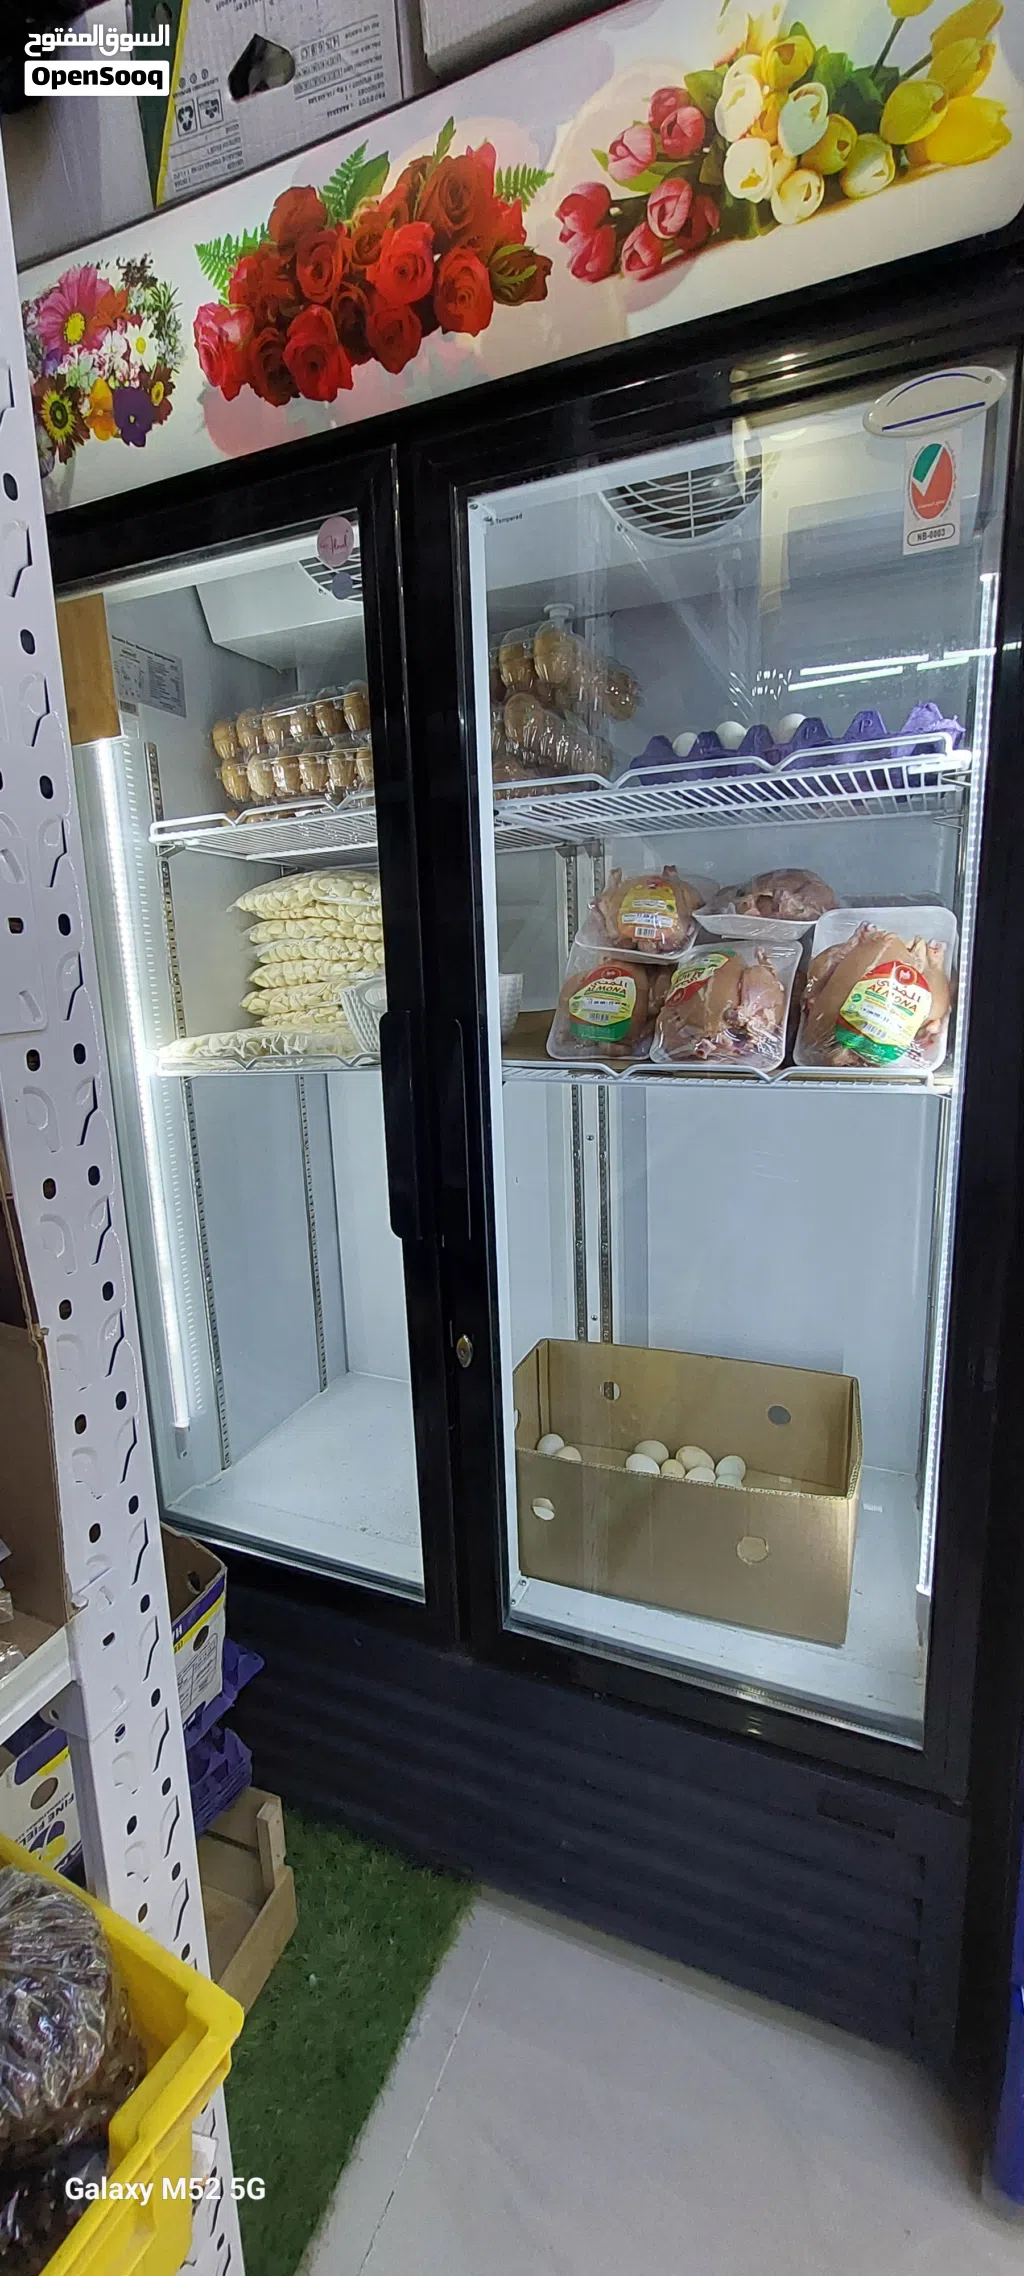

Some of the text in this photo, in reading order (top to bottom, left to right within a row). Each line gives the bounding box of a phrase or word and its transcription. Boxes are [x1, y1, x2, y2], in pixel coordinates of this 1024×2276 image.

[917, 528, 946, 541] NB-0003
[586, 985, 627, 996] ALMONA
[20, 1792, 75, 1847] FINE FIEL
